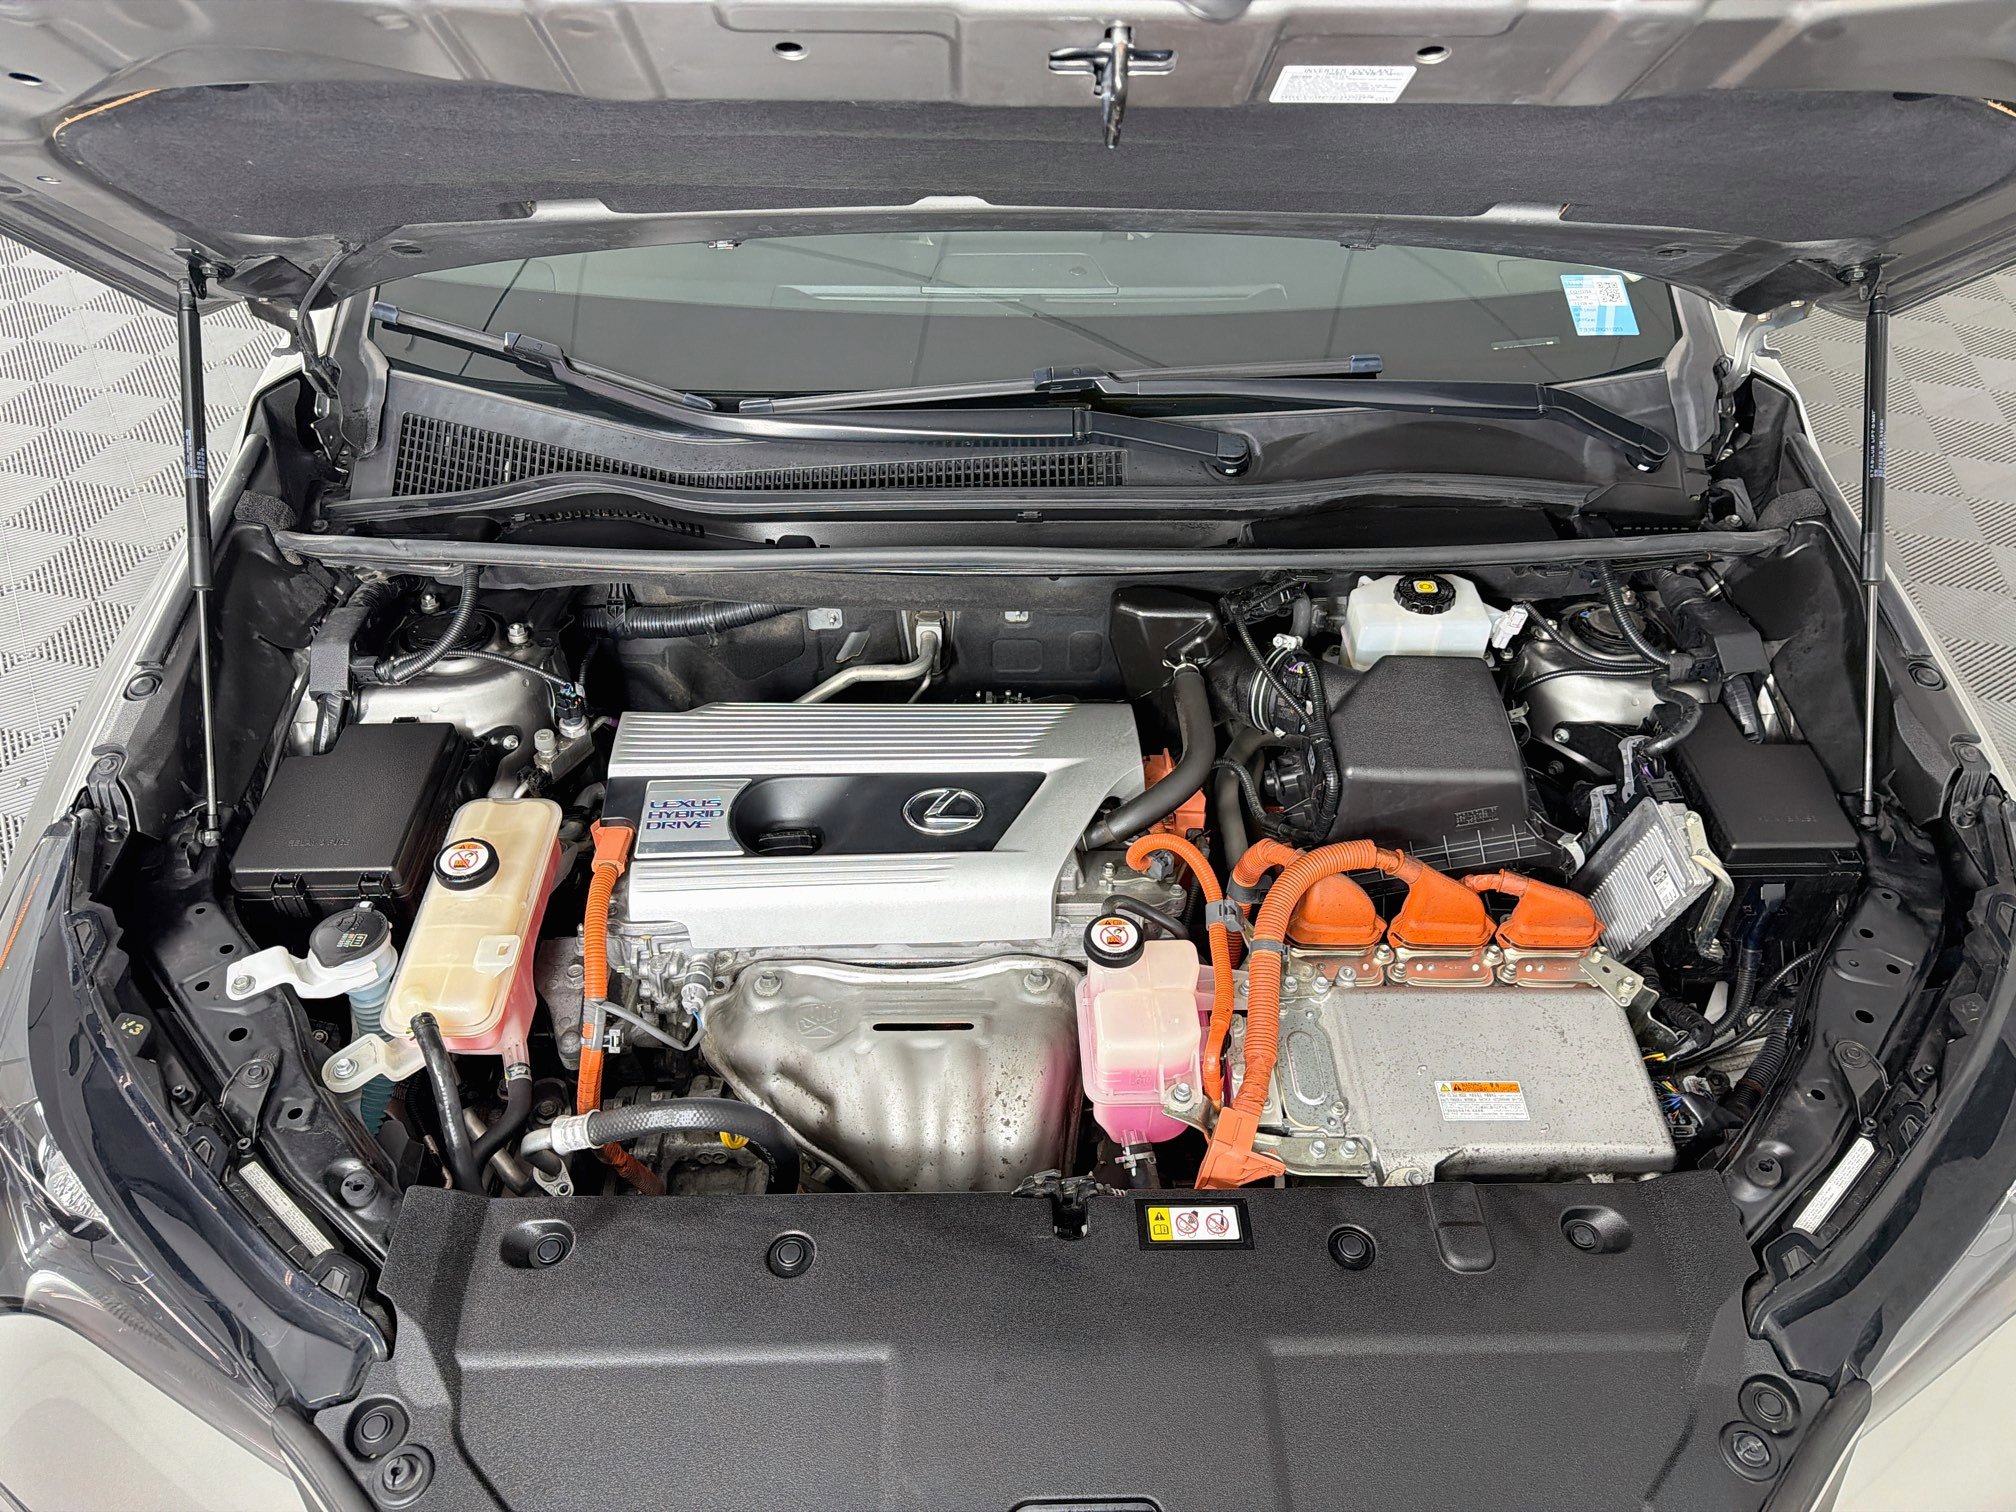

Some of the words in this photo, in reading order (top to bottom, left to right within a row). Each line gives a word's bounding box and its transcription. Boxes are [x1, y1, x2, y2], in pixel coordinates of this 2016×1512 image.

[650, 799, 722, 809] LEXUS
[648, 809, 725, 819] HYBRID
[646, 820, 712, 830] DRIVE
